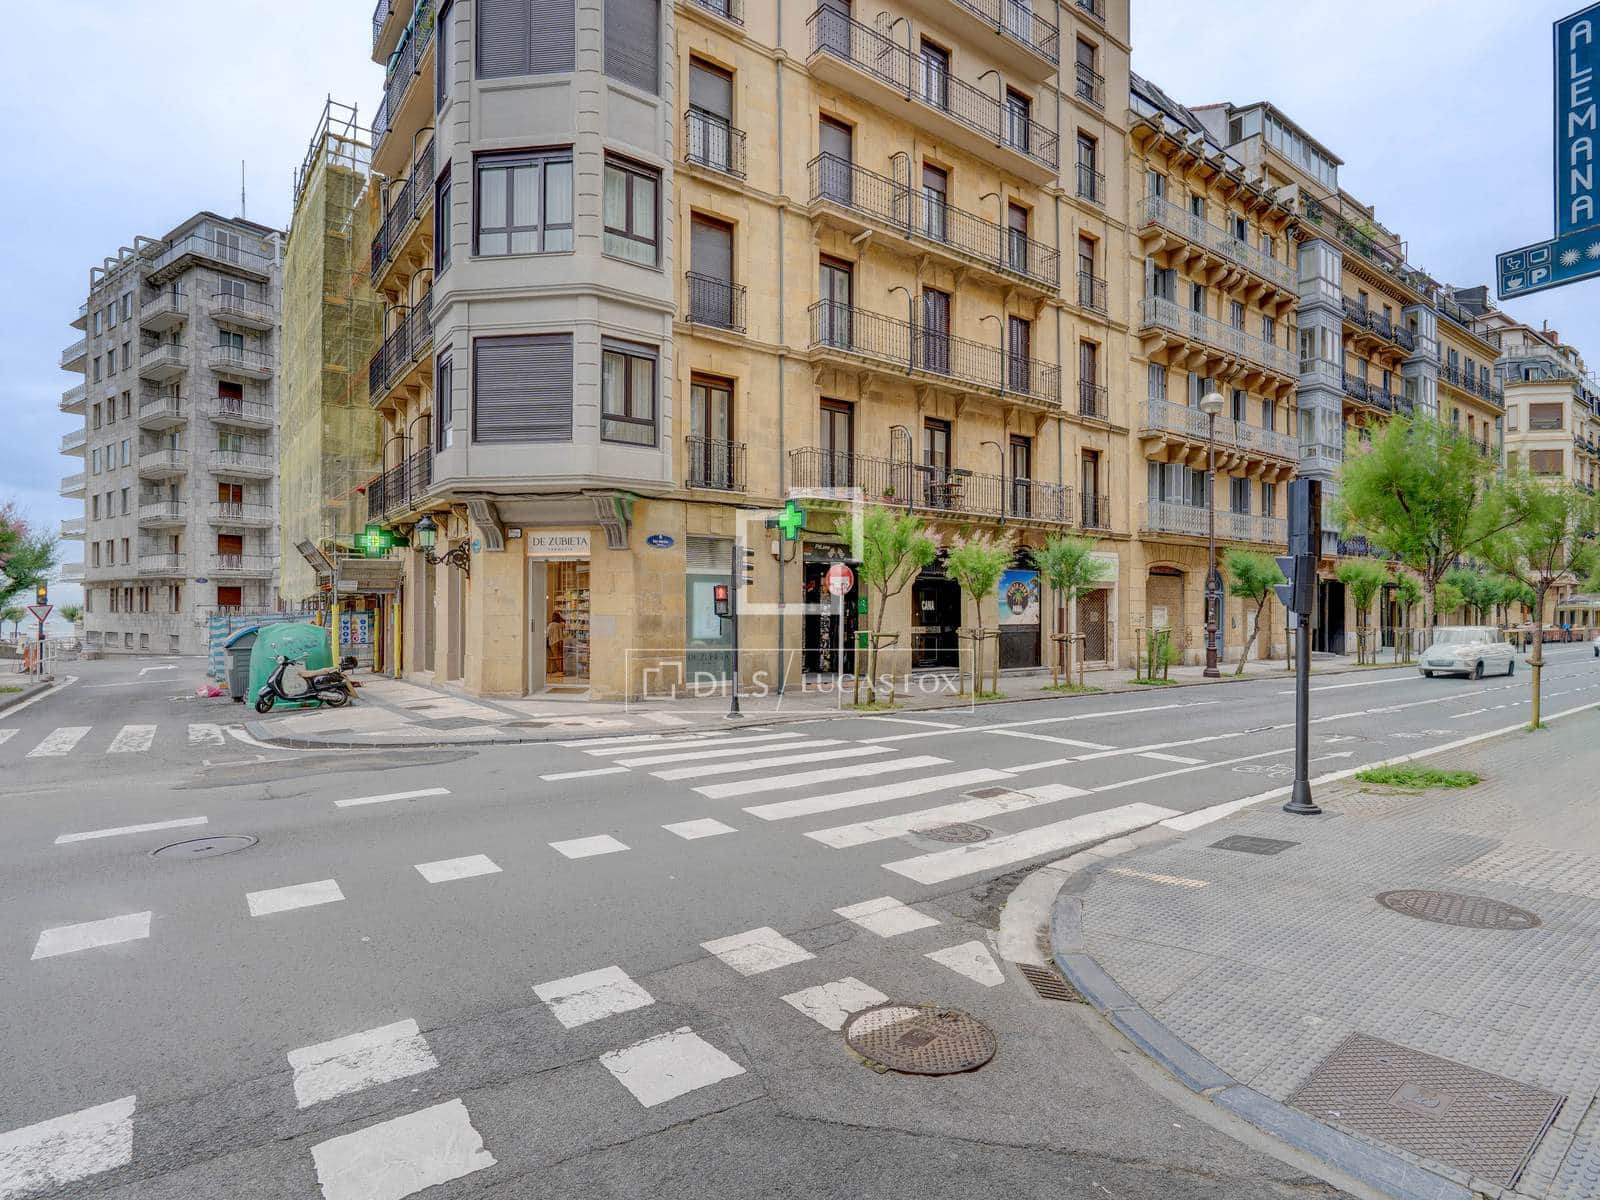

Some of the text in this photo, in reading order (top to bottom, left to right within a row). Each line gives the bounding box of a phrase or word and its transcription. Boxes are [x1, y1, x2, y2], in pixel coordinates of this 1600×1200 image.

[1568, 19, 1597, 225] ALEMANA
[1531, 267, 1547, 284] P
[532, 536, 588, 546] DE ZUBIETA
